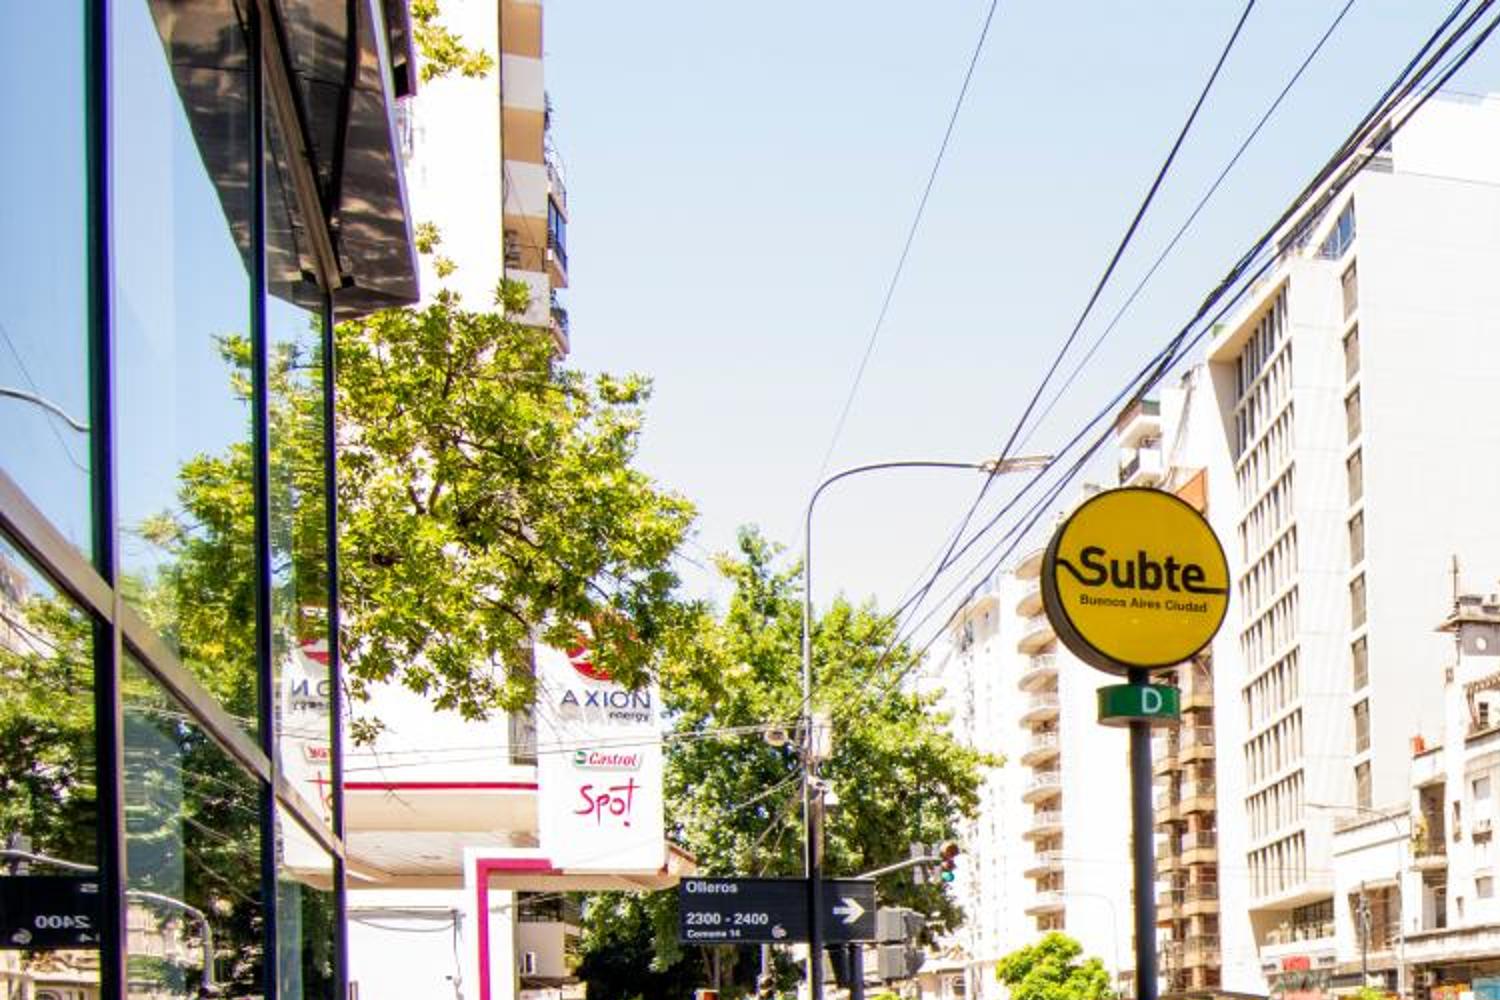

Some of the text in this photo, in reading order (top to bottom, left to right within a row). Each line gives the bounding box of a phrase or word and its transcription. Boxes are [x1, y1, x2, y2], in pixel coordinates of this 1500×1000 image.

[1066, 546, 1222, 593] Subte
[1079, 594, 1208, 613] Buenos Aires Ciudad
[561, 689, 650, 709] AXION
[1141, 687, 1163, 713] D
[609, 711, 649, 722] energy
[589, 752, 638, 766] Castrol
[685, 881, 738, 894] Olleros
[686, 912, 721, 925] 2300
[734, 912, 768, 925] 2400
